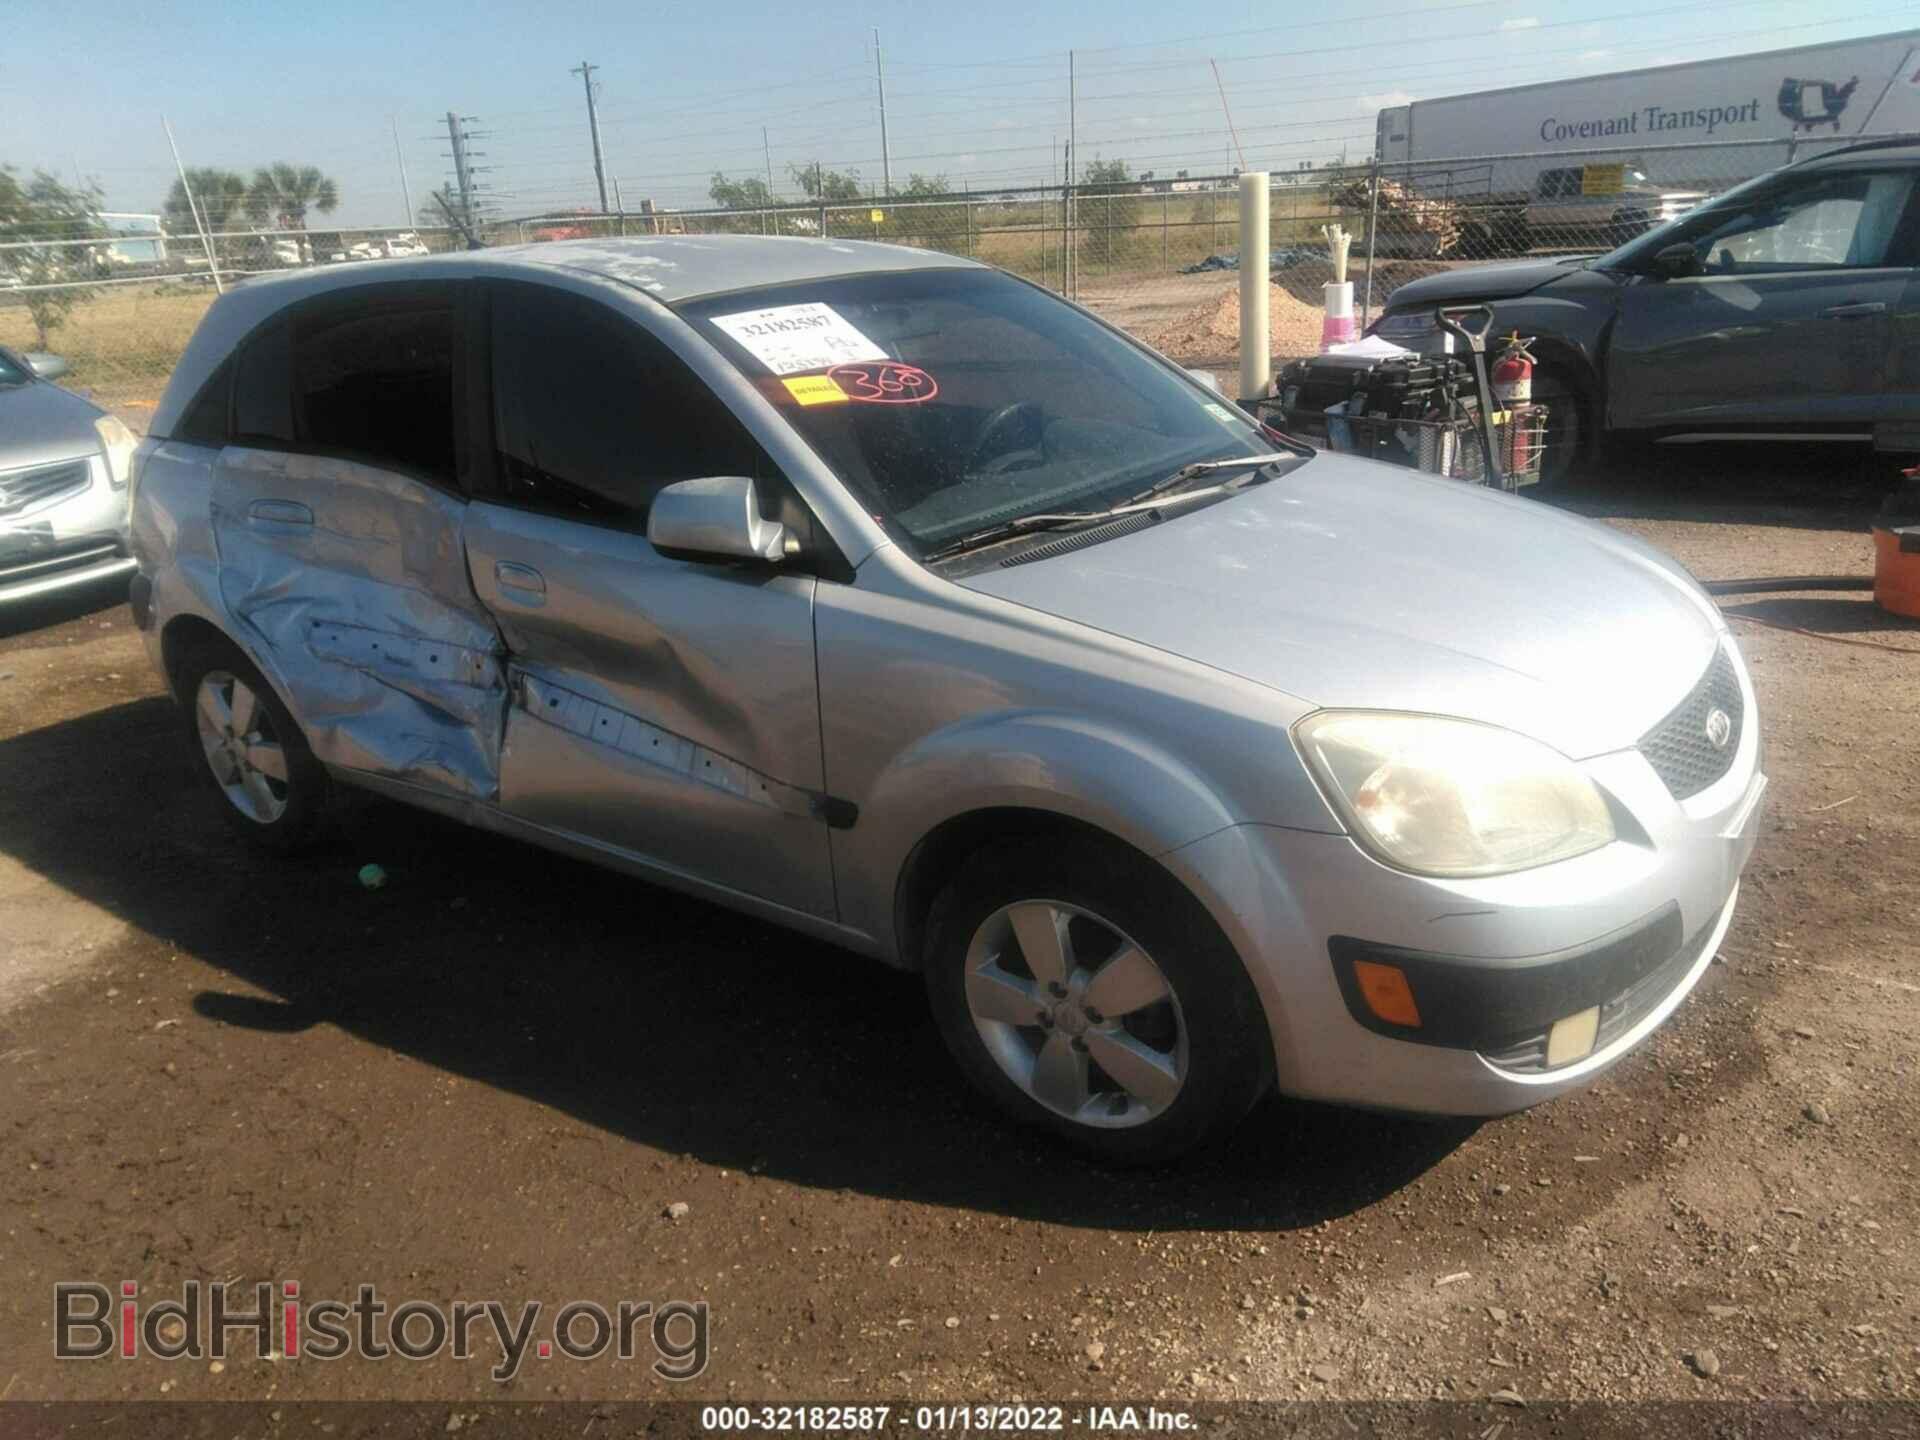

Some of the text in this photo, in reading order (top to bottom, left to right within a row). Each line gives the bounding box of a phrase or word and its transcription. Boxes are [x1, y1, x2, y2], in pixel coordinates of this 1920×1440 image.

[1540, 98, 1760, 142] Covenant Transport
[738, 315, 832, 337] 32182587
